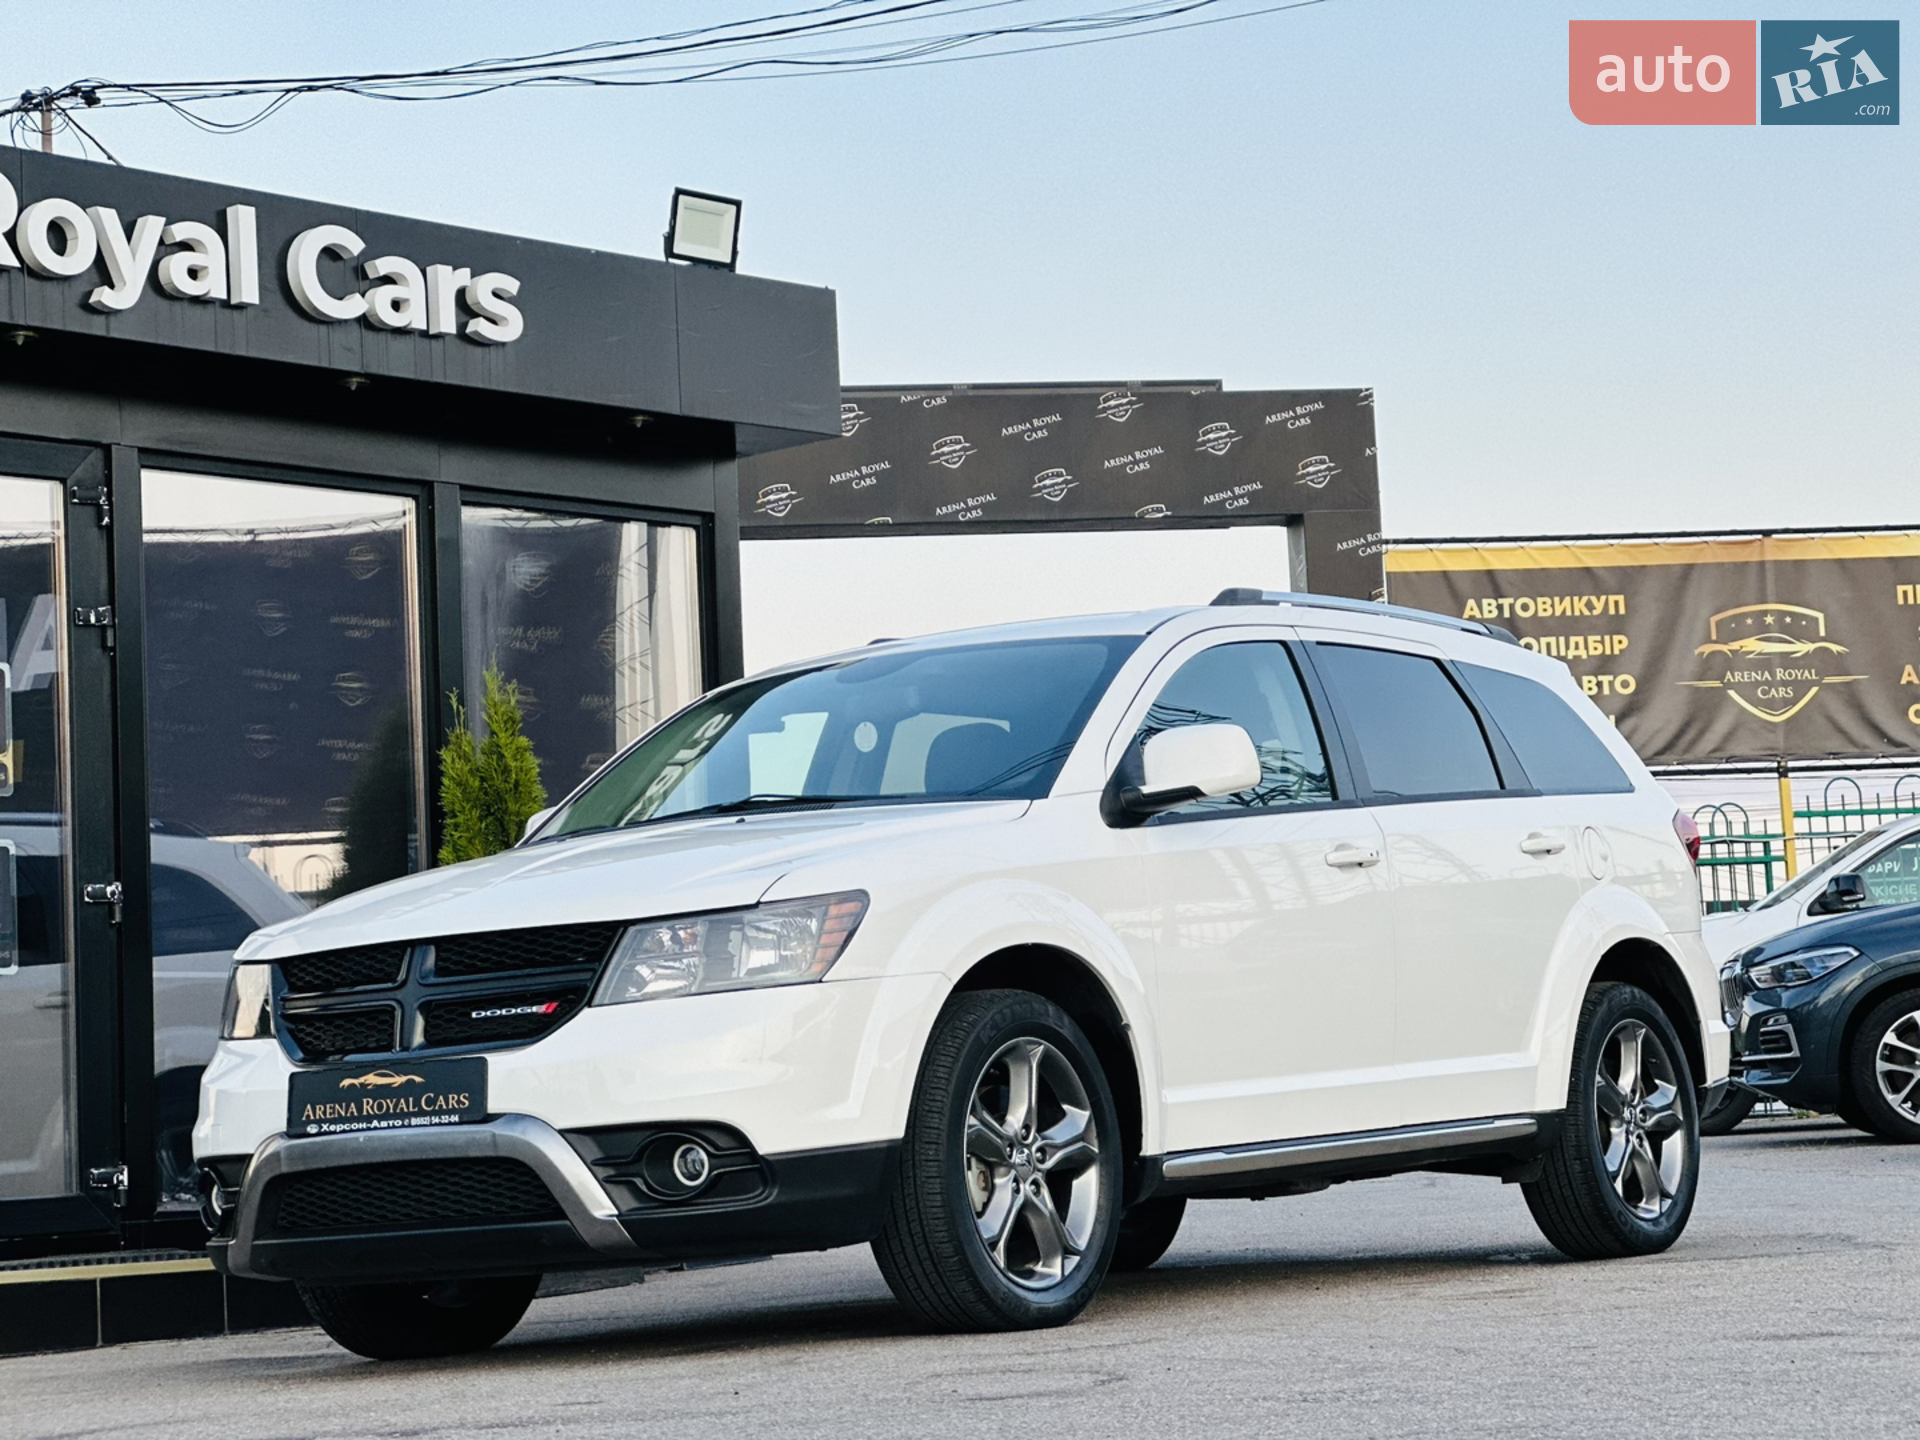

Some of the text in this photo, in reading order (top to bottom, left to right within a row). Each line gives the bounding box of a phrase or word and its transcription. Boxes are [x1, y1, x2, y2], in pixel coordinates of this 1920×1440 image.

[0, 172, 524, 343] oyal Cars
[922, 395, 948, 408] CARS
[1264, 400, 1325, 425] ARENA ROYAL
[1001, 412, 1063, 437] ARENA ROYAL
[1287, 415, 1312, 429] CARS
[1023, 428, 1049, 442] CARS
[1103, 445, 1165, 469] ARENA ROYAL
[829, 460, 892, 485] ARENA ROYAL
[1126, 461, 1150, 474] CARS
[851, 475, 877, 489] CARS
[1203, 480, 1264, 505] ARENA ROYAL
[935, 492, 998, 516] ARENA ROYAL
[1225, 496, 1250, 509] CARS
[957, 507, 983, 522] CARS
[1336, 537, 1366, 552] ARENA
[1358, 543, 1382, 557] CARS
[1462, 594, 1626, 620] АВТОВИКУП
[1724, 667, 1819, 684] ARENA ROYAL
[1573, 673, 1637, 696] ВТО
[1757, 685, 1794, 699] CARS
[471, 1004, 546, 1018] DODGE
[301, 1092, 470, 1121] ARENA ROYAL CARS
[320, 1118, 402, 1133] Херсон-Авто
